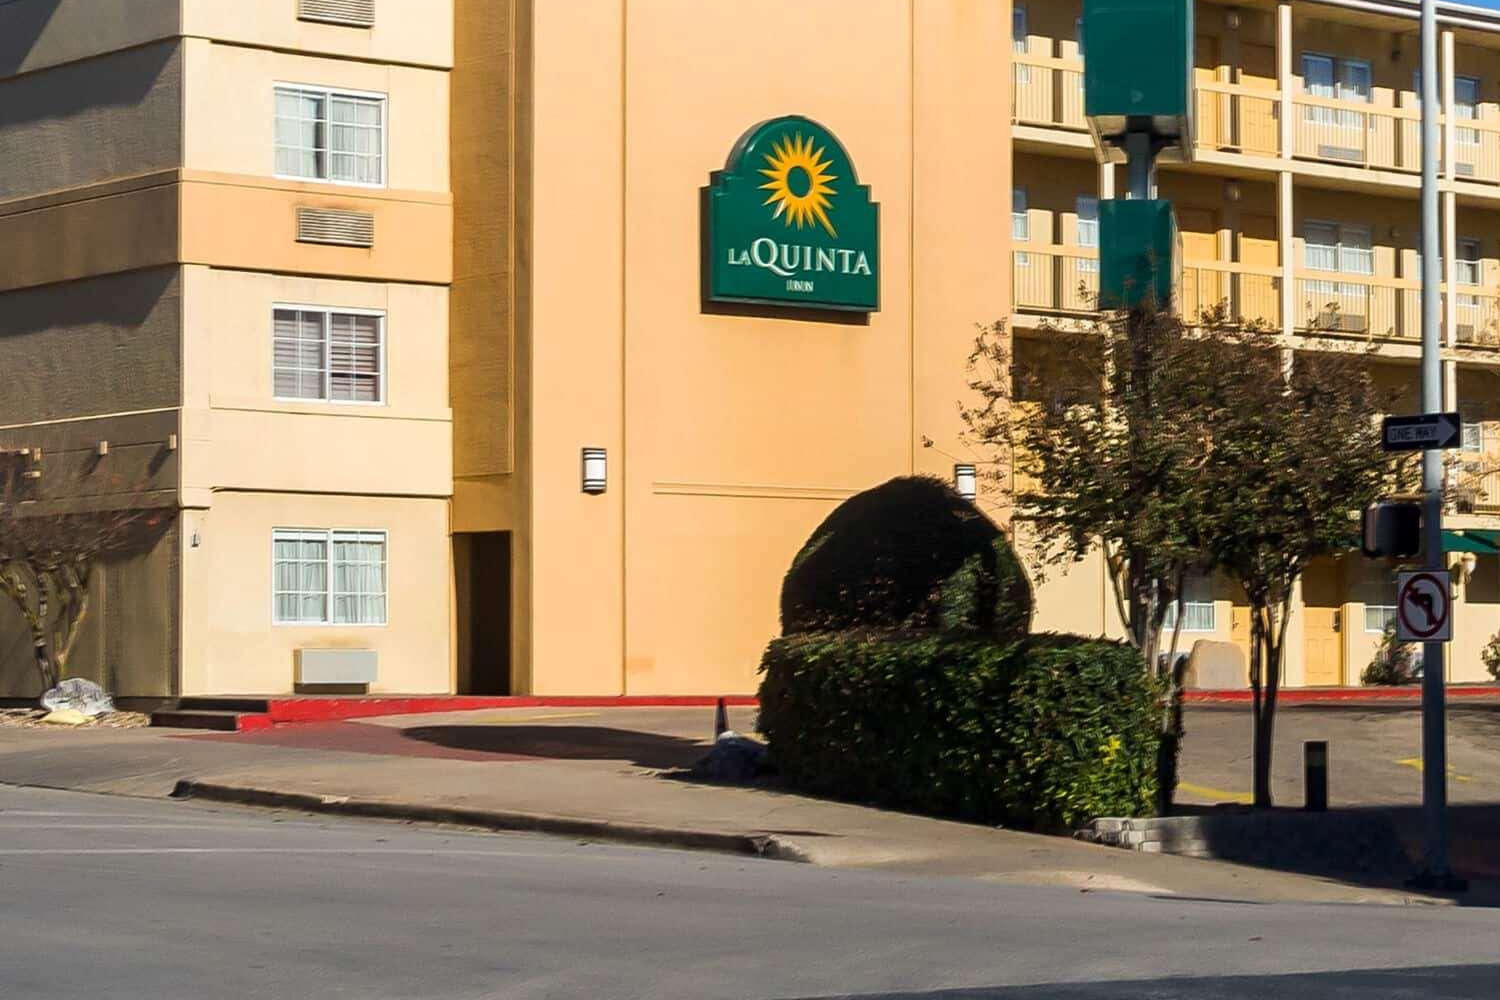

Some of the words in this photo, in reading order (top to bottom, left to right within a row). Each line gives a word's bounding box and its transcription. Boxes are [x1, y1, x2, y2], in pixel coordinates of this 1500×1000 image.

[751, 238, 872, 276] QUINTA
[786, 280, 814, 292] INN
[1390, 427, 1413, 441] ONE
